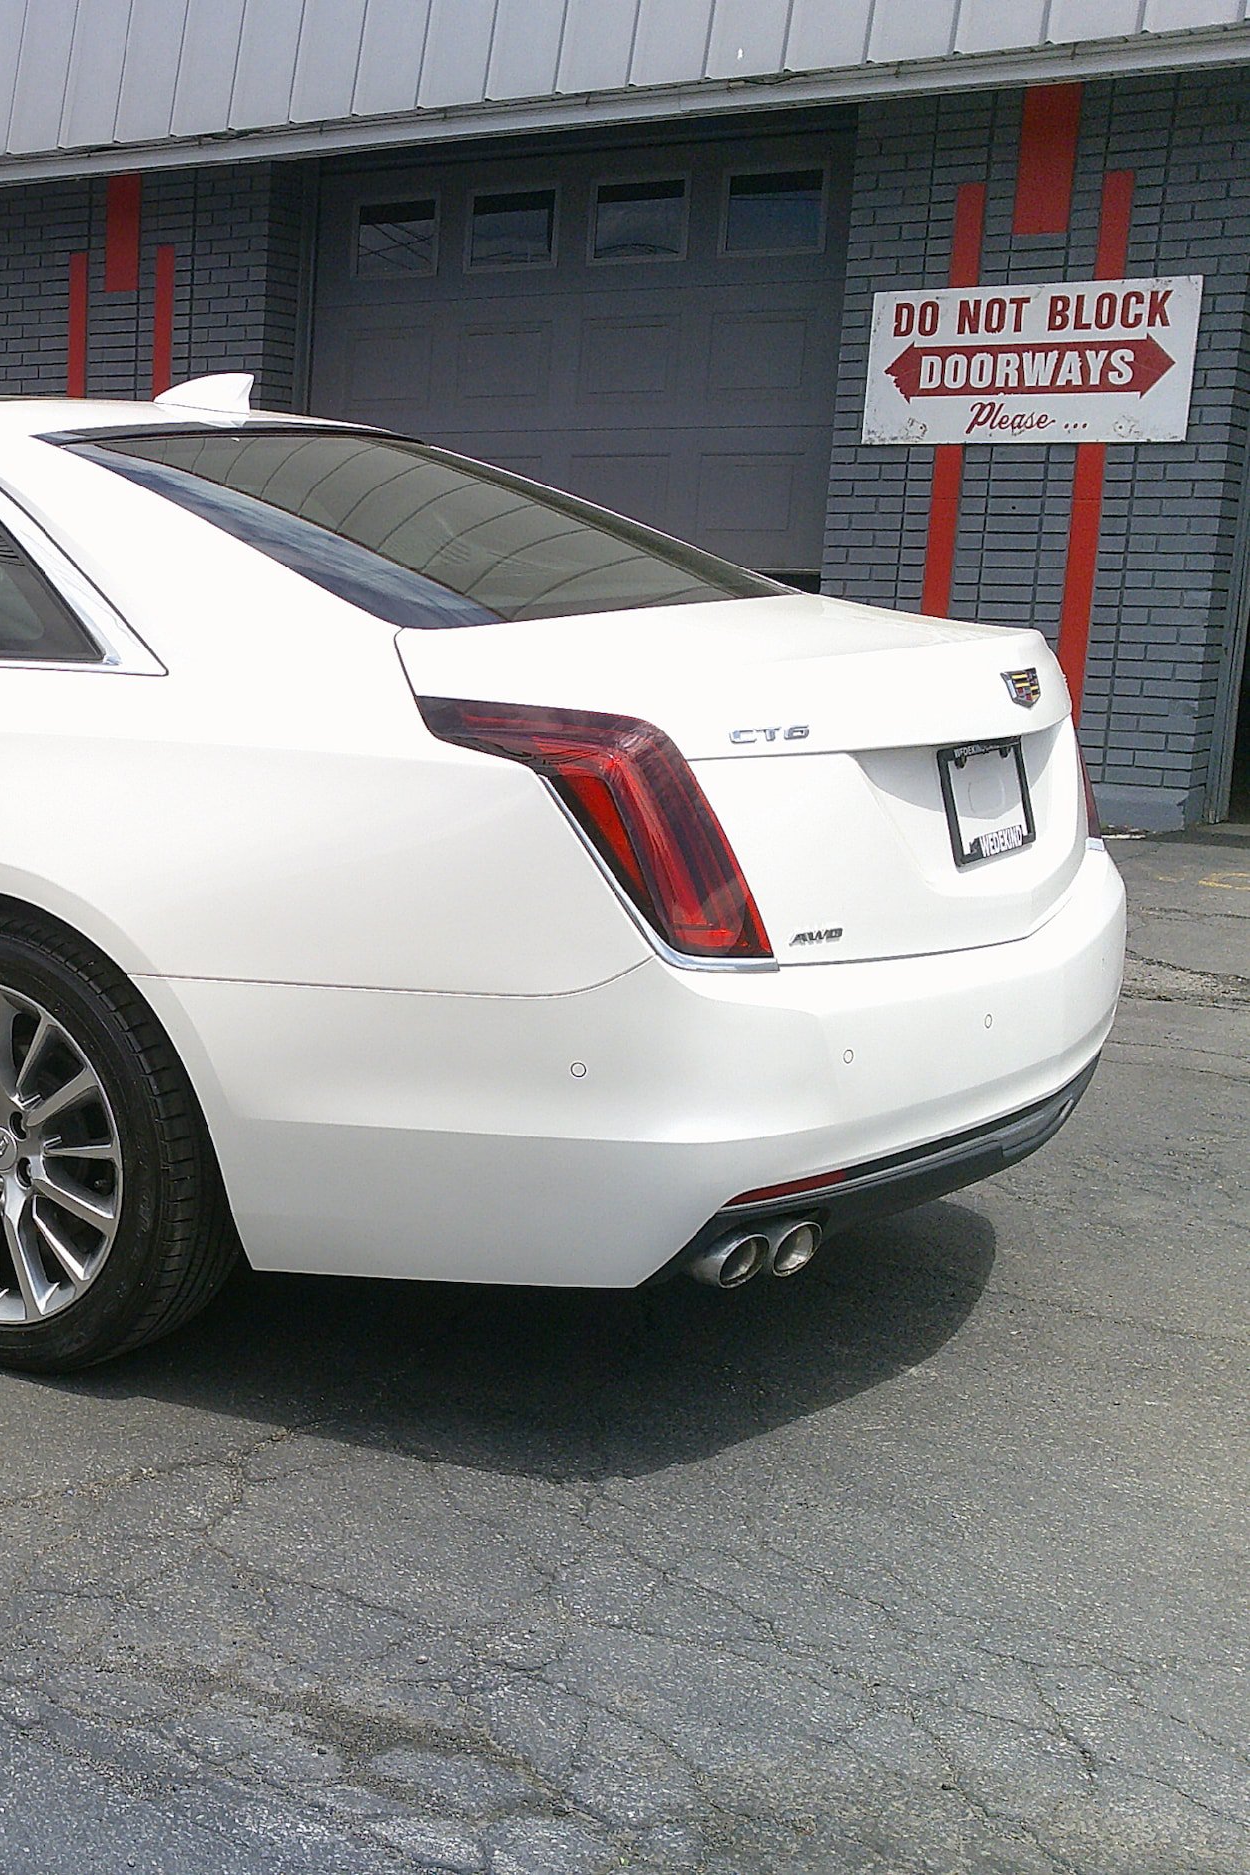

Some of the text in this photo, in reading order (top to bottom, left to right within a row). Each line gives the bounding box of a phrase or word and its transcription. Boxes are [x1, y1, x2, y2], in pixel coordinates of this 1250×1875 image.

[893, 290, 1174, 337] DO NOT BLOCK
[919, 348, 1135, 389] DOORWAYS
[966, 401, 1056, 434] Please
[729, 724, 810, 744] CT6
[979, 825, 1023, 857] WEDEKIND
[789, 928, 842, 946] AWD
